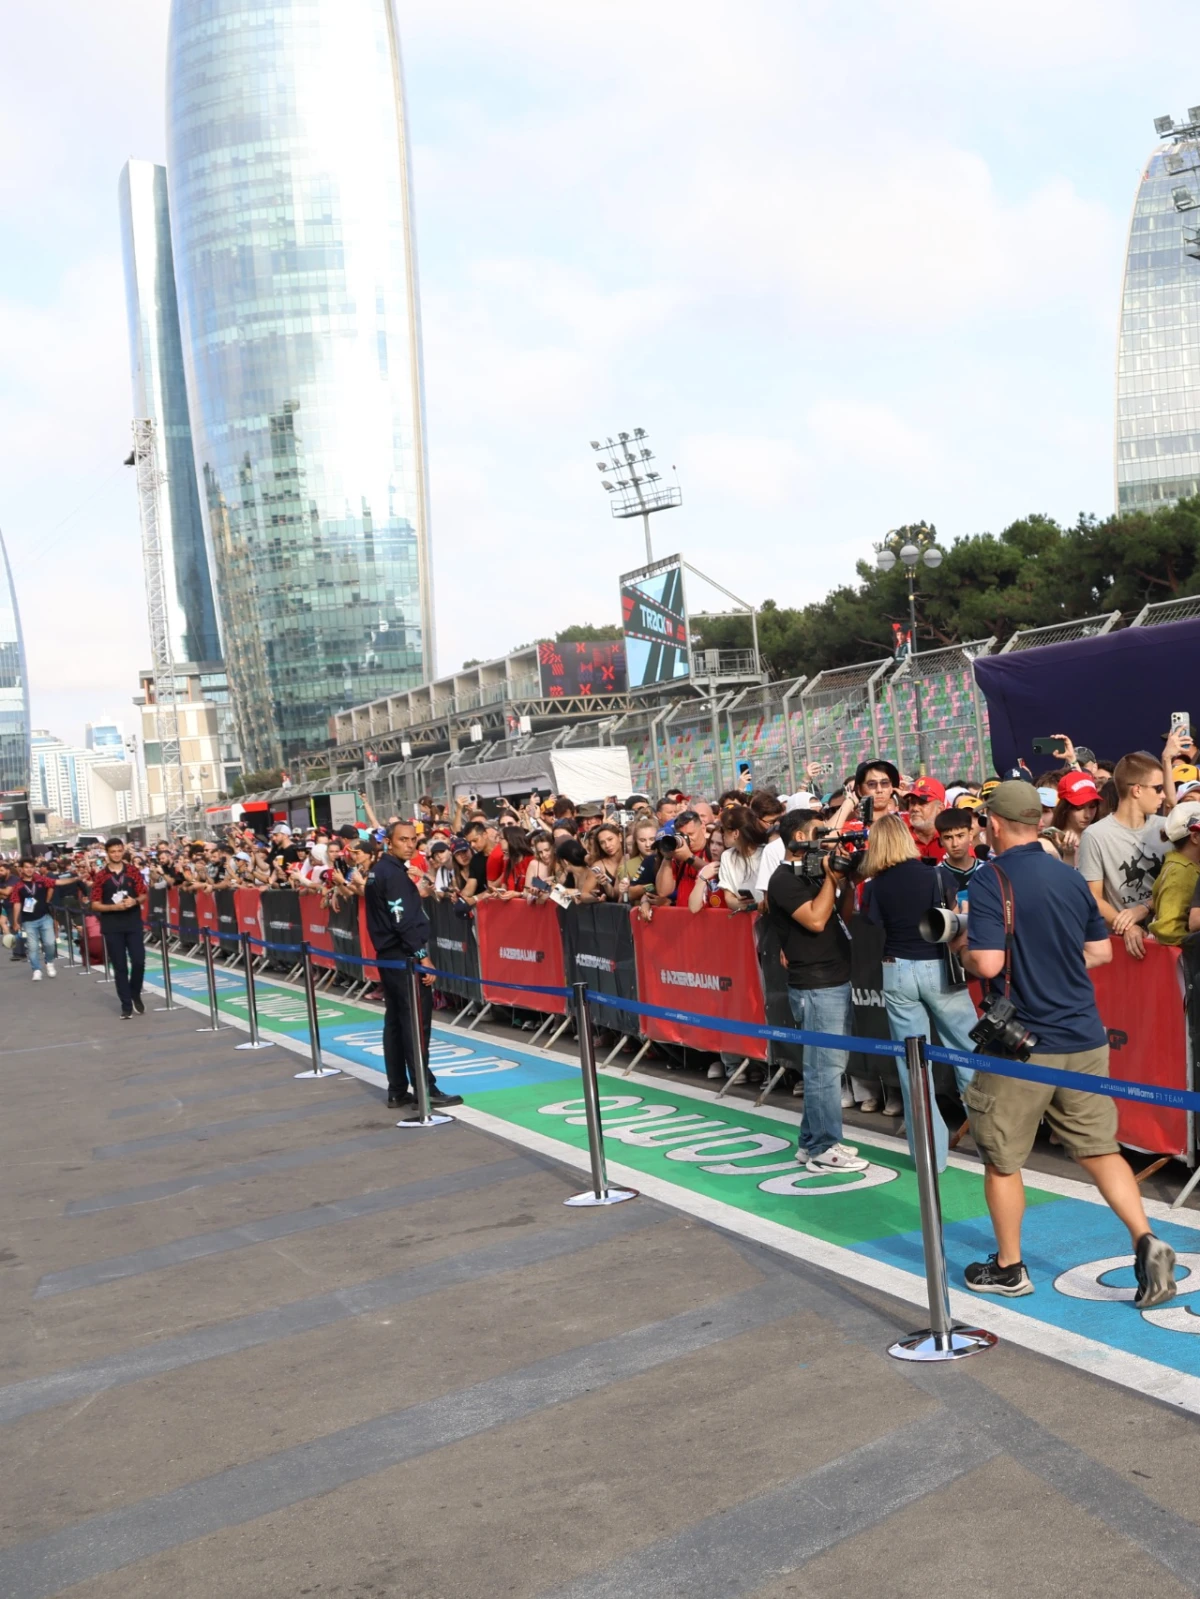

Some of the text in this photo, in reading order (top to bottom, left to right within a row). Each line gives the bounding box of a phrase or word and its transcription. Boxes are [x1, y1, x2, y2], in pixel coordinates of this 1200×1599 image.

[639, 603, 667, 635] TRACK
[1127, 1086, 1155, 1099] Williams
[1155, 1092, 1163, 1101] F1
[1164, 1094, 1184, 1104] TEAM
